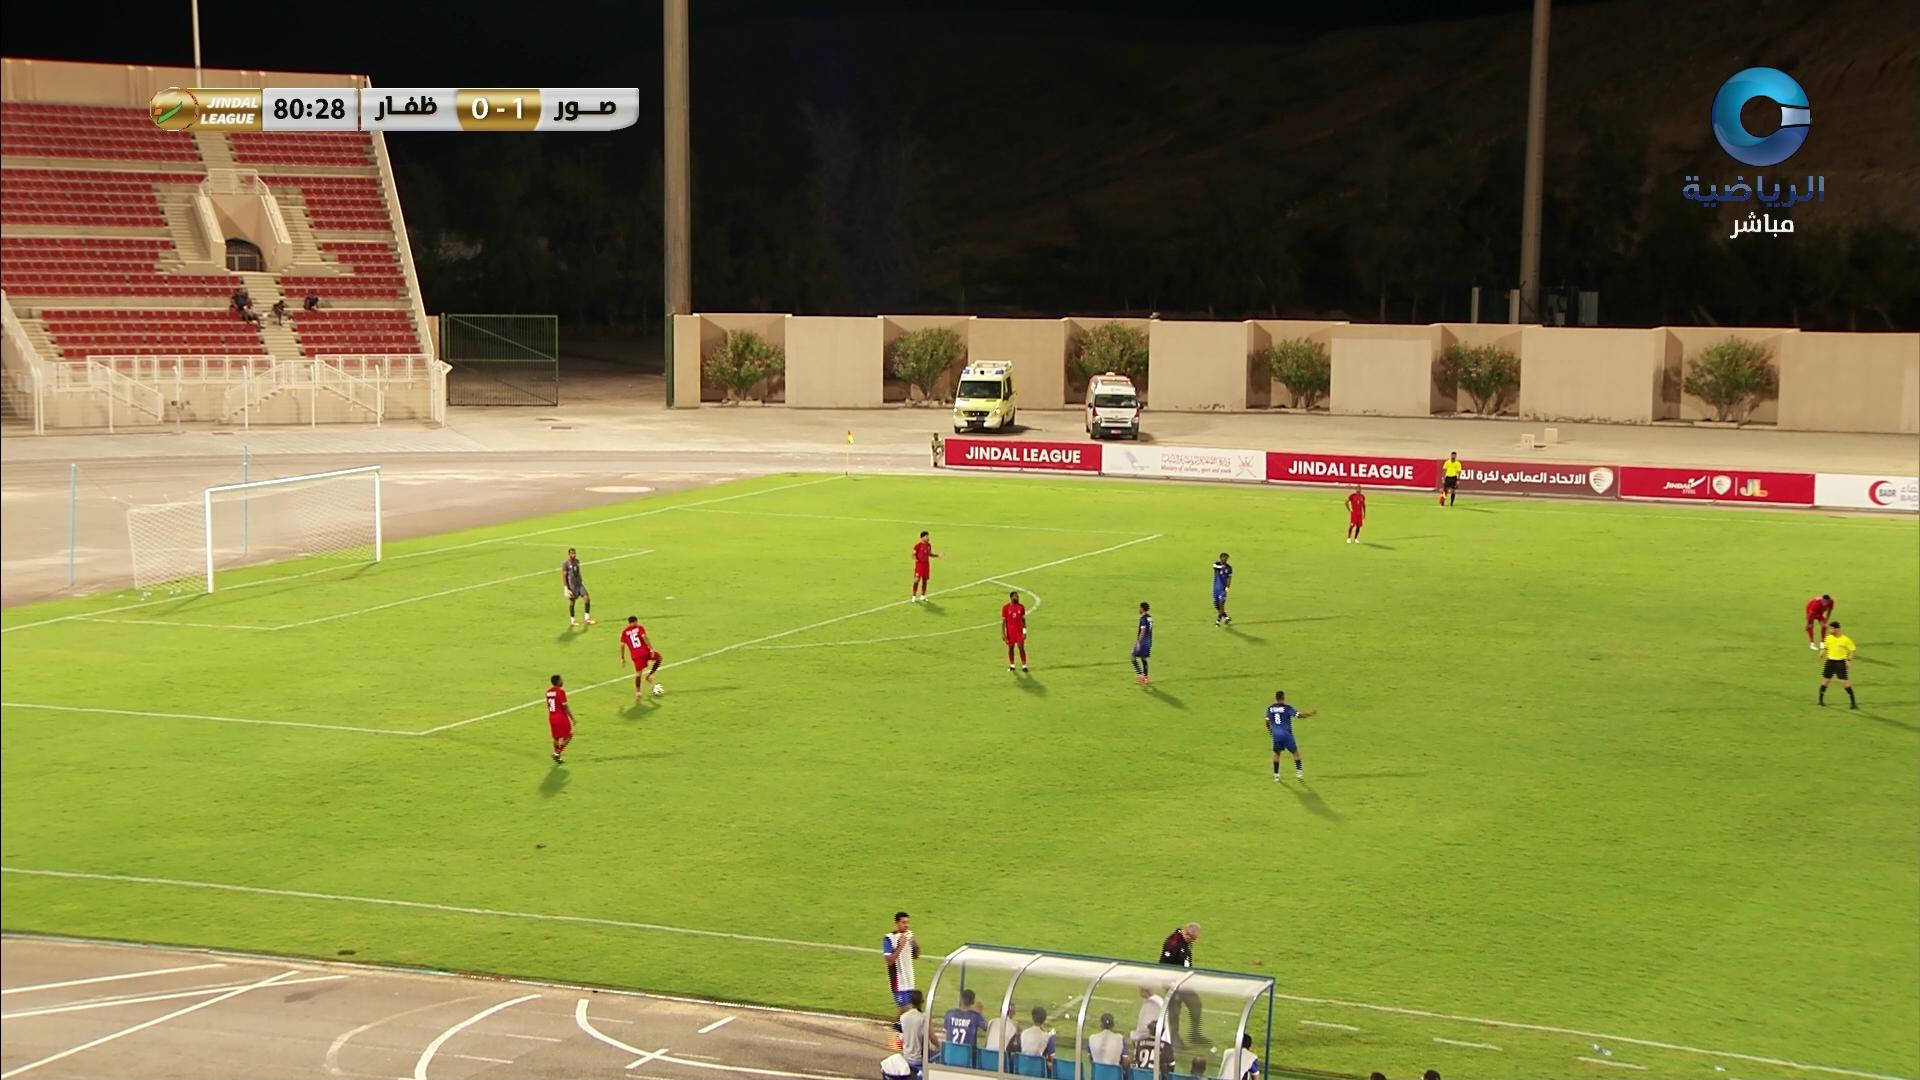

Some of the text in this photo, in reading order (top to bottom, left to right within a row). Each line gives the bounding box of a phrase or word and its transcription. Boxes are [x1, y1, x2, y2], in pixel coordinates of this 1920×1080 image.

[965, 446, 1081, 464] JINDAL LEAGUE
[1288, 460, 1414, 480] JINDAL LEAGUE
[1476, 470, 1499, 483] لكرة
[1501, 471, 1547, 484] العماني
[1549, 473, 1586, 485] الاتحاد
[1663, 481, 1693, 490] JINDAL
[629, 632, 642, 649] 15
[952, 1028, 967, 1045] 27
